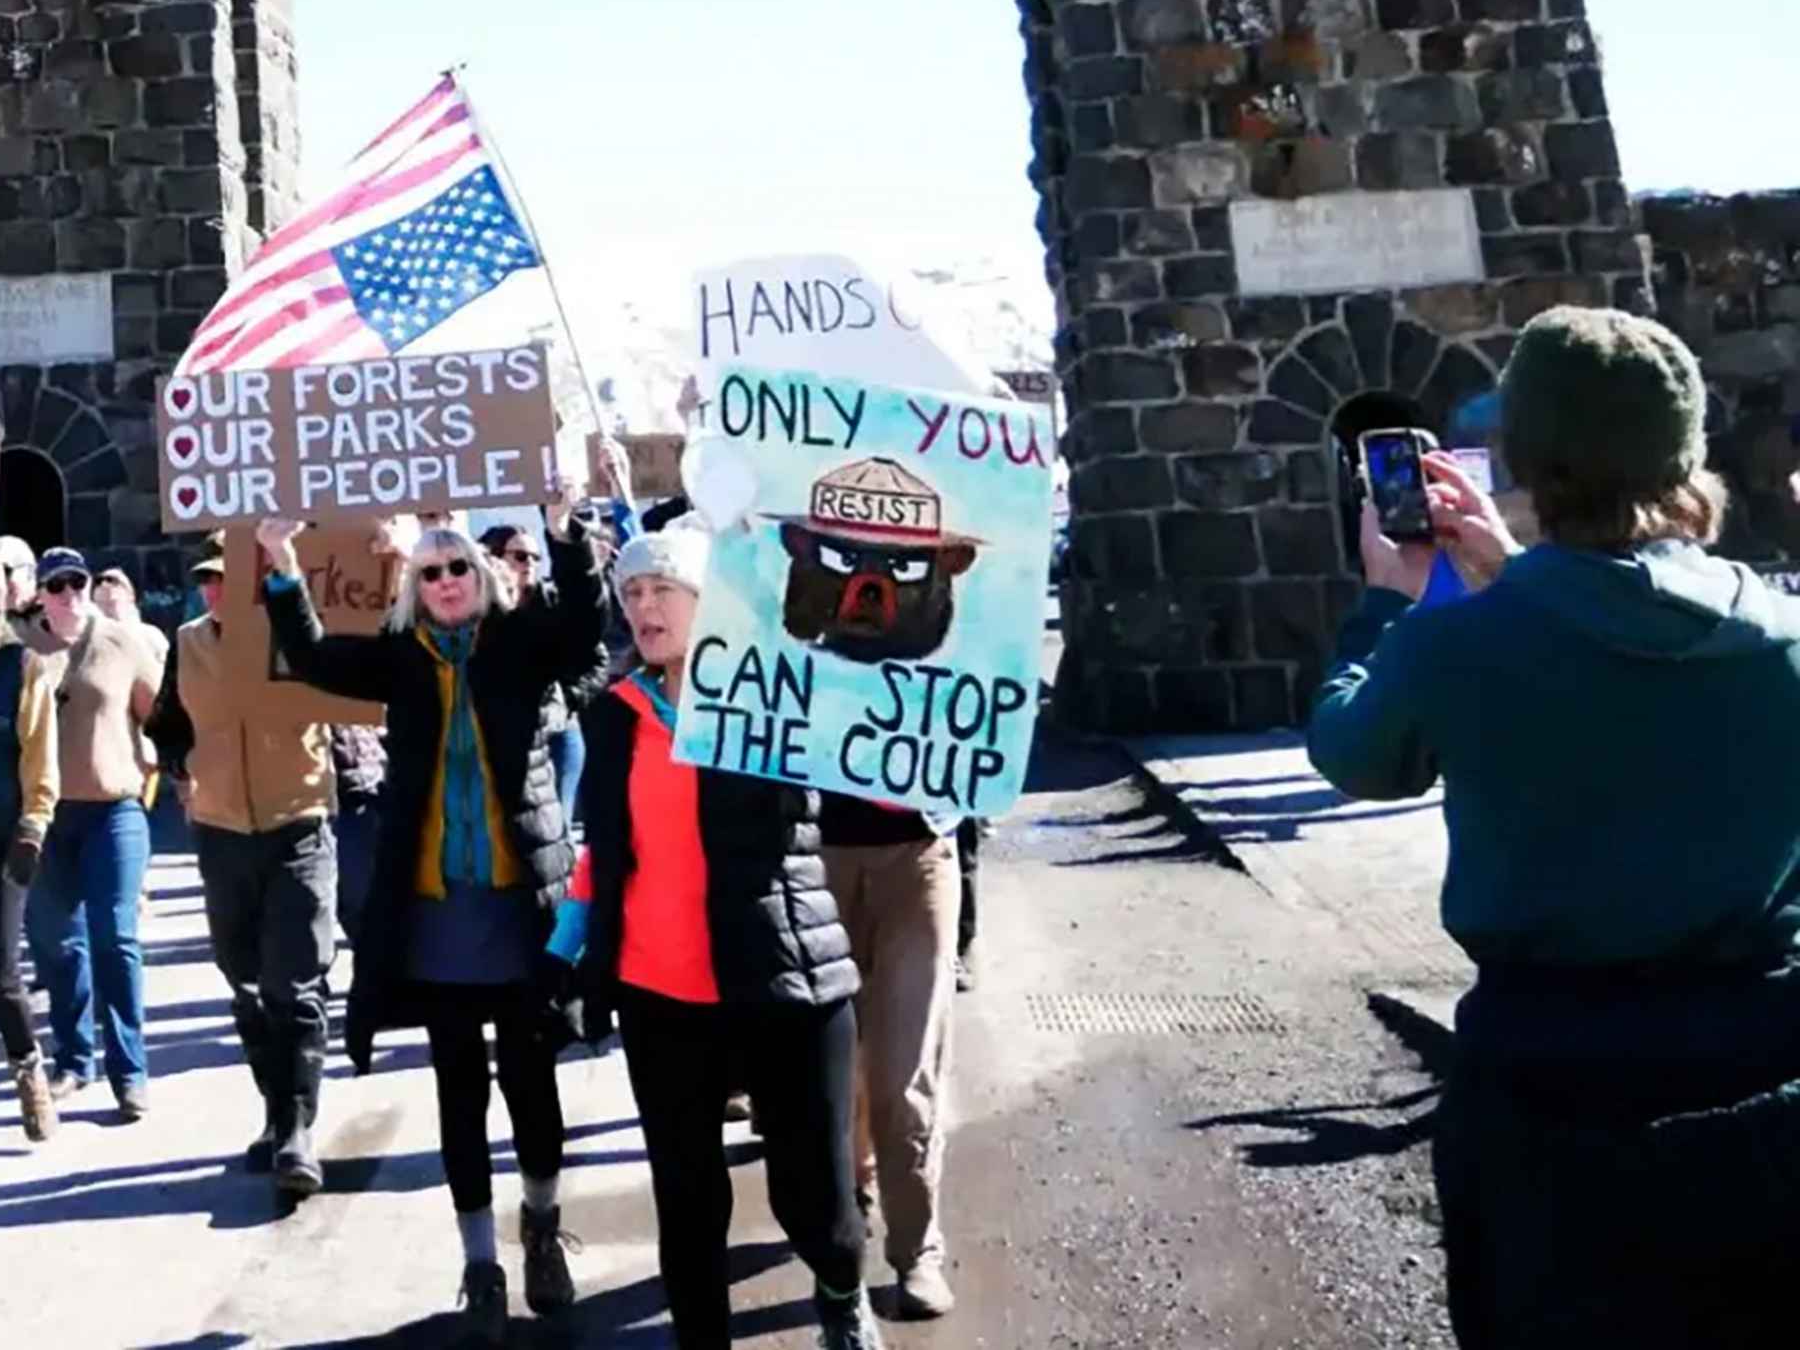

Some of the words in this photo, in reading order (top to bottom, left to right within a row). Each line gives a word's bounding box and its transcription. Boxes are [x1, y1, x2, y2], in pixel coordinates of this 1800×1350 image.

[700, 277, 877, 358] HANDS
[164, 370, 271, 420] OUR
[293, 348, 541, 410] FORESTS
[720, 374, 866, 449] ONLY
[908, 397, 1051, 468] YOU
[166, 418, 276, 469] OUR
[296, 404, 476, 460] PARKS
[170, 468, 280, 520] OUR
[300, 449, 525, 510] PEOPLE
[818, 487, 930, 526] RESIST
[690, 636, 815, 719] CAN
[866, 660, 1027, 747] STOP
[693, 703, 811, 782] THE
[840, 721, 1005, 811] COUP
